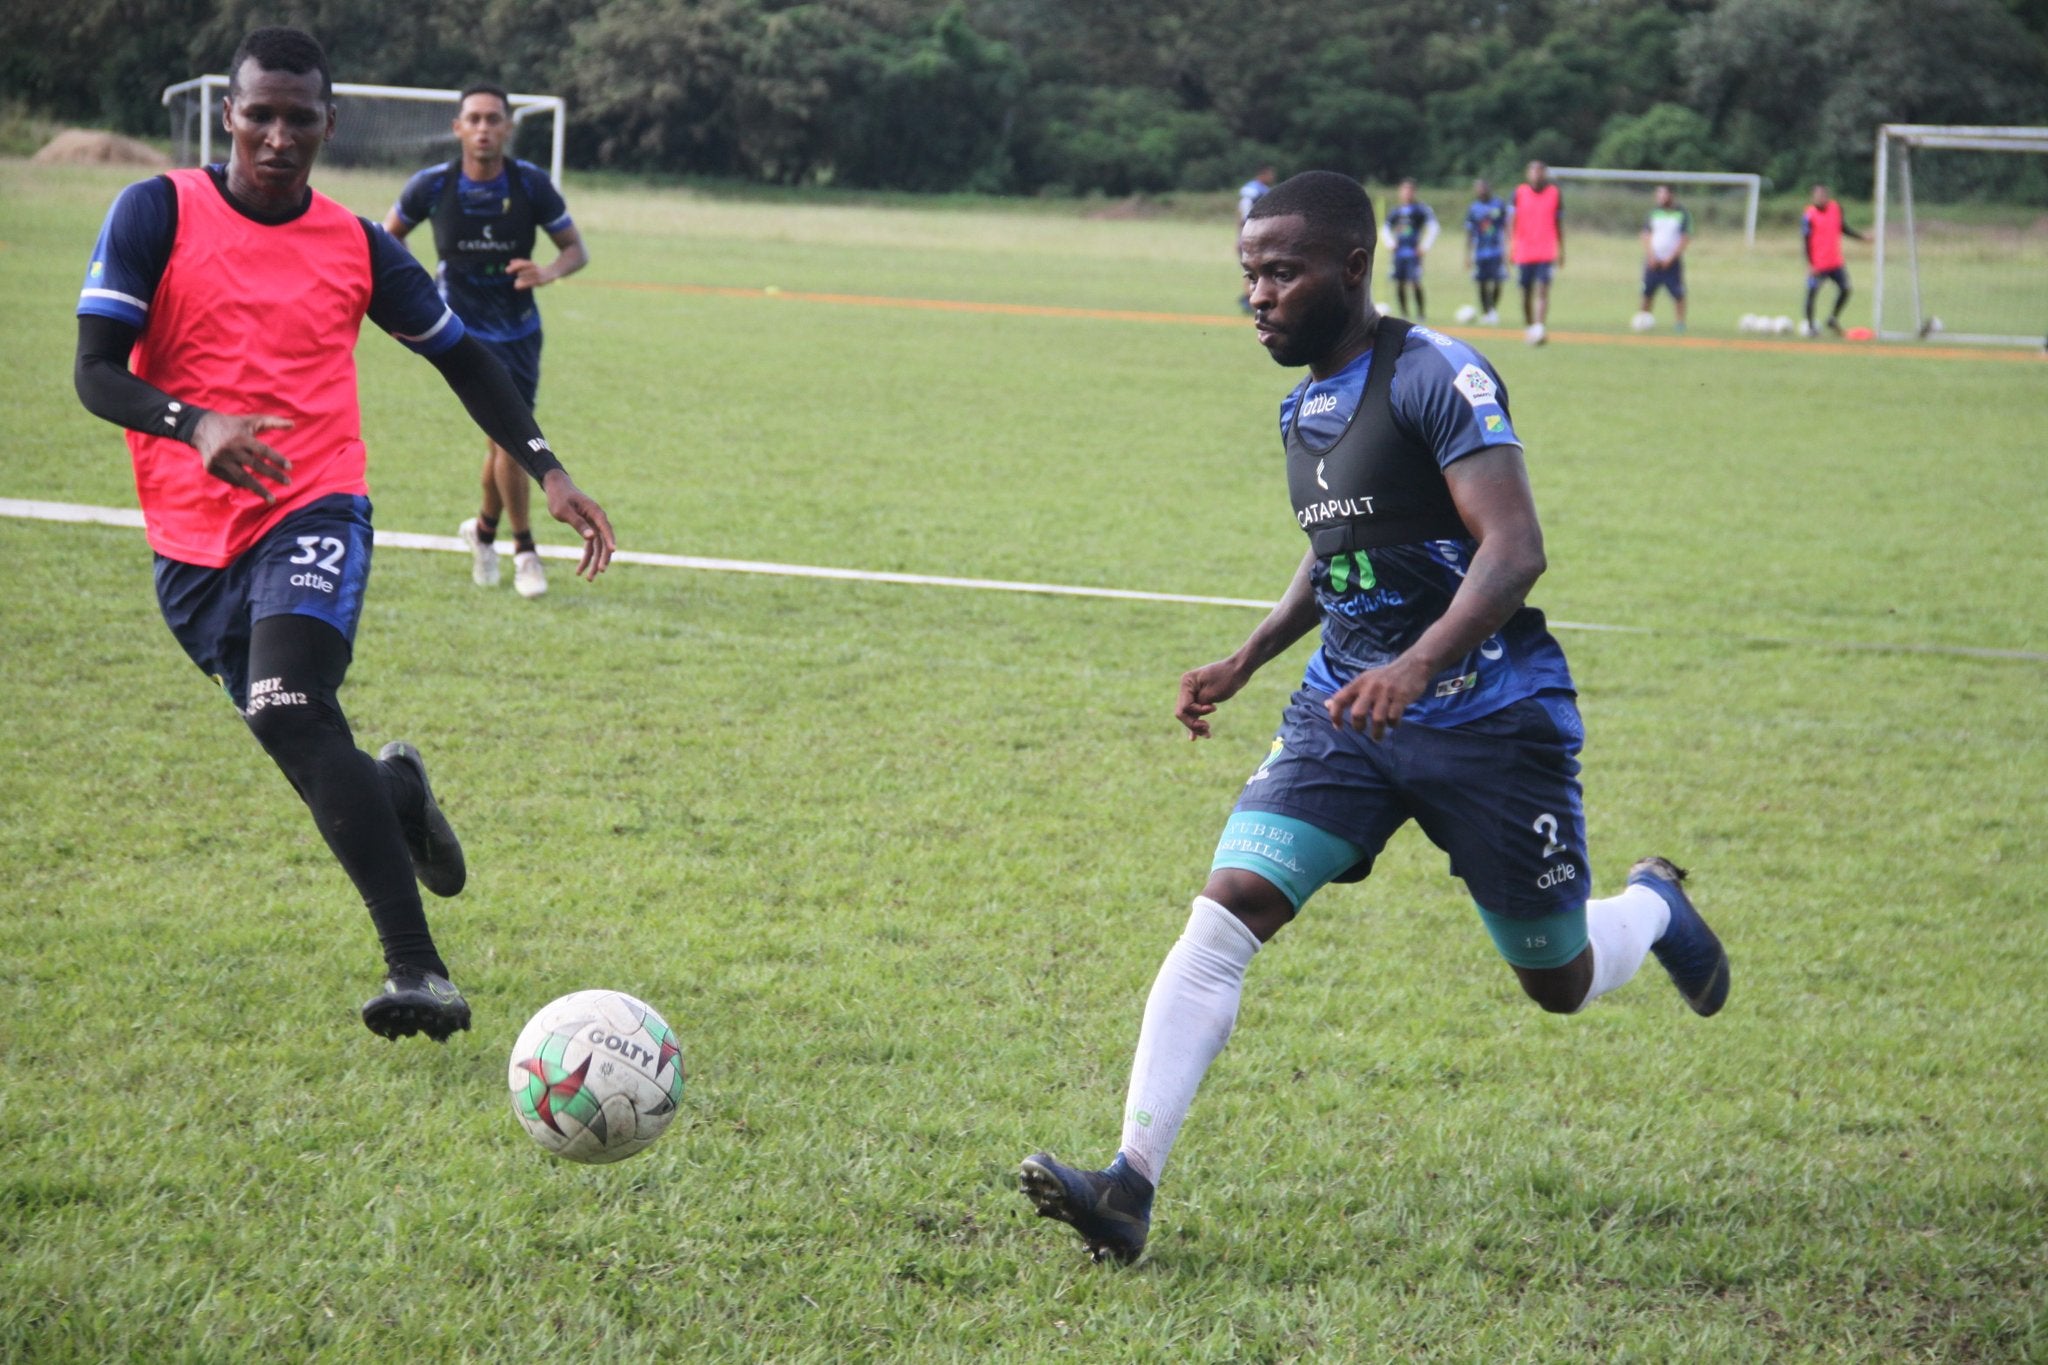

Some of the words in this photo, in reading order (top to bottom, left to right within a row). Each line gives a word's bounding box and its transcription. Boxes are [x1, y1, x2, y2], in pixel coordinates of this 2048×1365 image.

[457, 240, 516, 251] CATAPULT
[1303, 393, 1337, 417] attle
[1297, 496, 1374, 528] CATAPULT
[289, 536, 345, 575] 32
[289, 572, 334, 593] attle
[1533, 813, 1567, 858] 2
[1537, 863, 1576, 889] attle
[1526, 936, 1547, 948] 18
[588, 1030, 654, 1067] GOLTY
